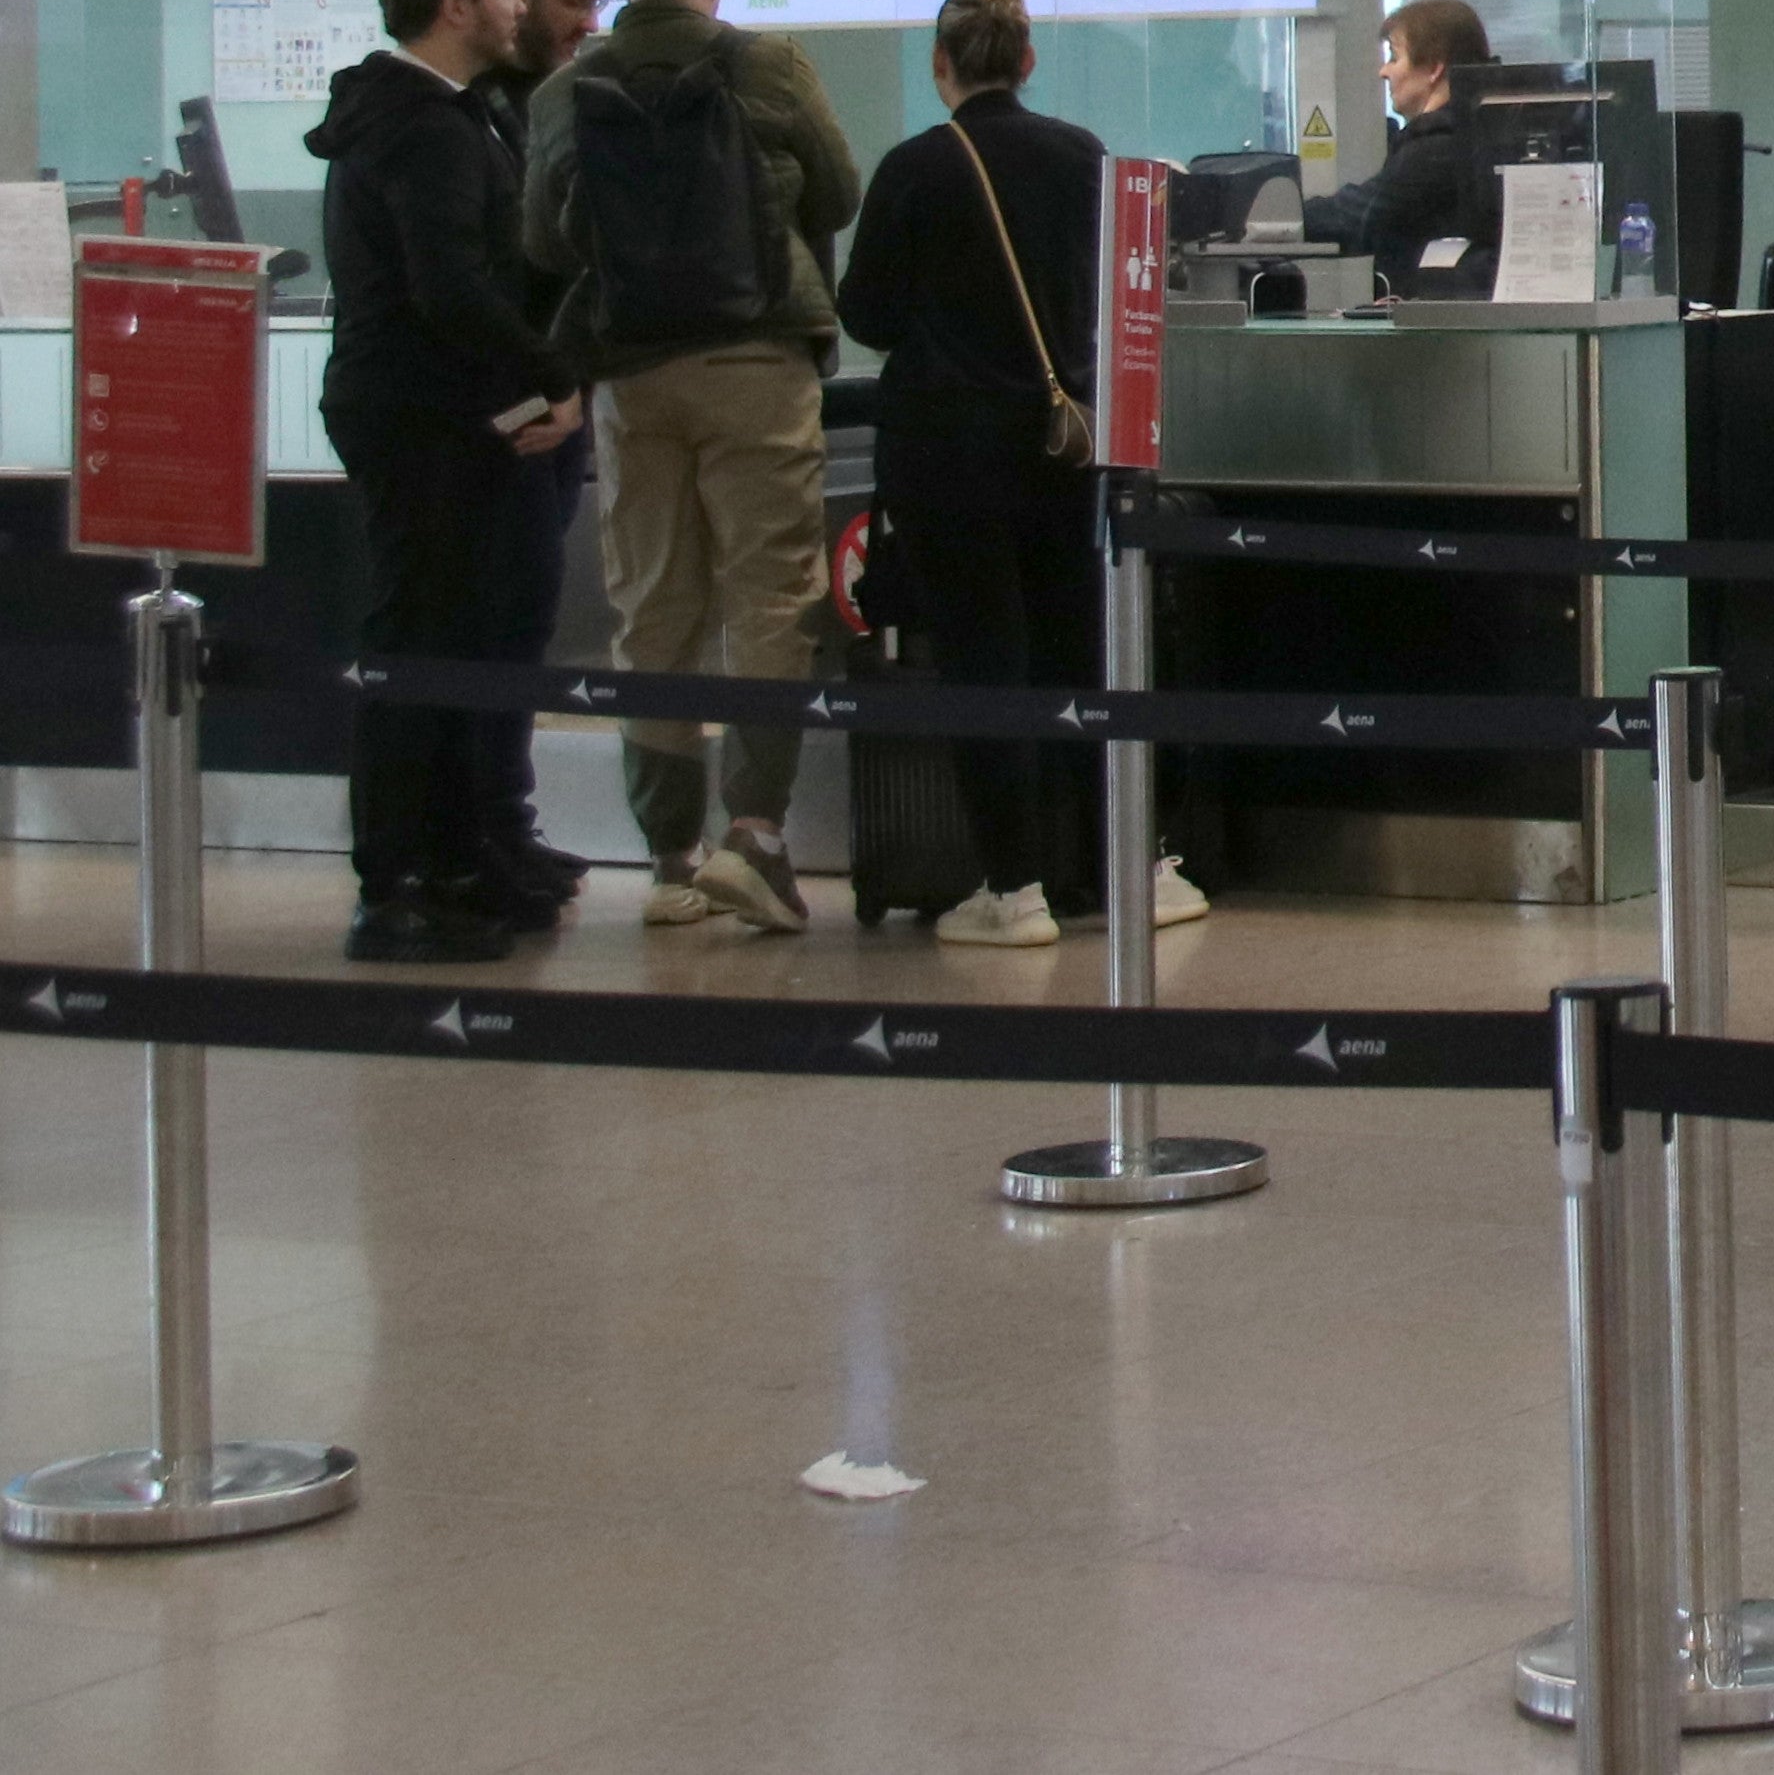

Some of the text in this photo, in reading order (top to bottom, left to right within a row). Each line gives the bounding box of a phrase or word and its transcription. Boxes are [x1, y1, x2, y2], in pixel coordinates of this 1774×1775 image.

[590, 687, 617, 698] aena
[830, 700, 857, 712] aena
[1081, 709, 1110, 721] aena
[1345, 715, 1375, 726] aena
[63, 992, 107, 1009] aena
[468, 1014, 514, 1031] aena
[892, 1031, 939, 1048] aena
[1338, 1039, 1387, 1056] aena
